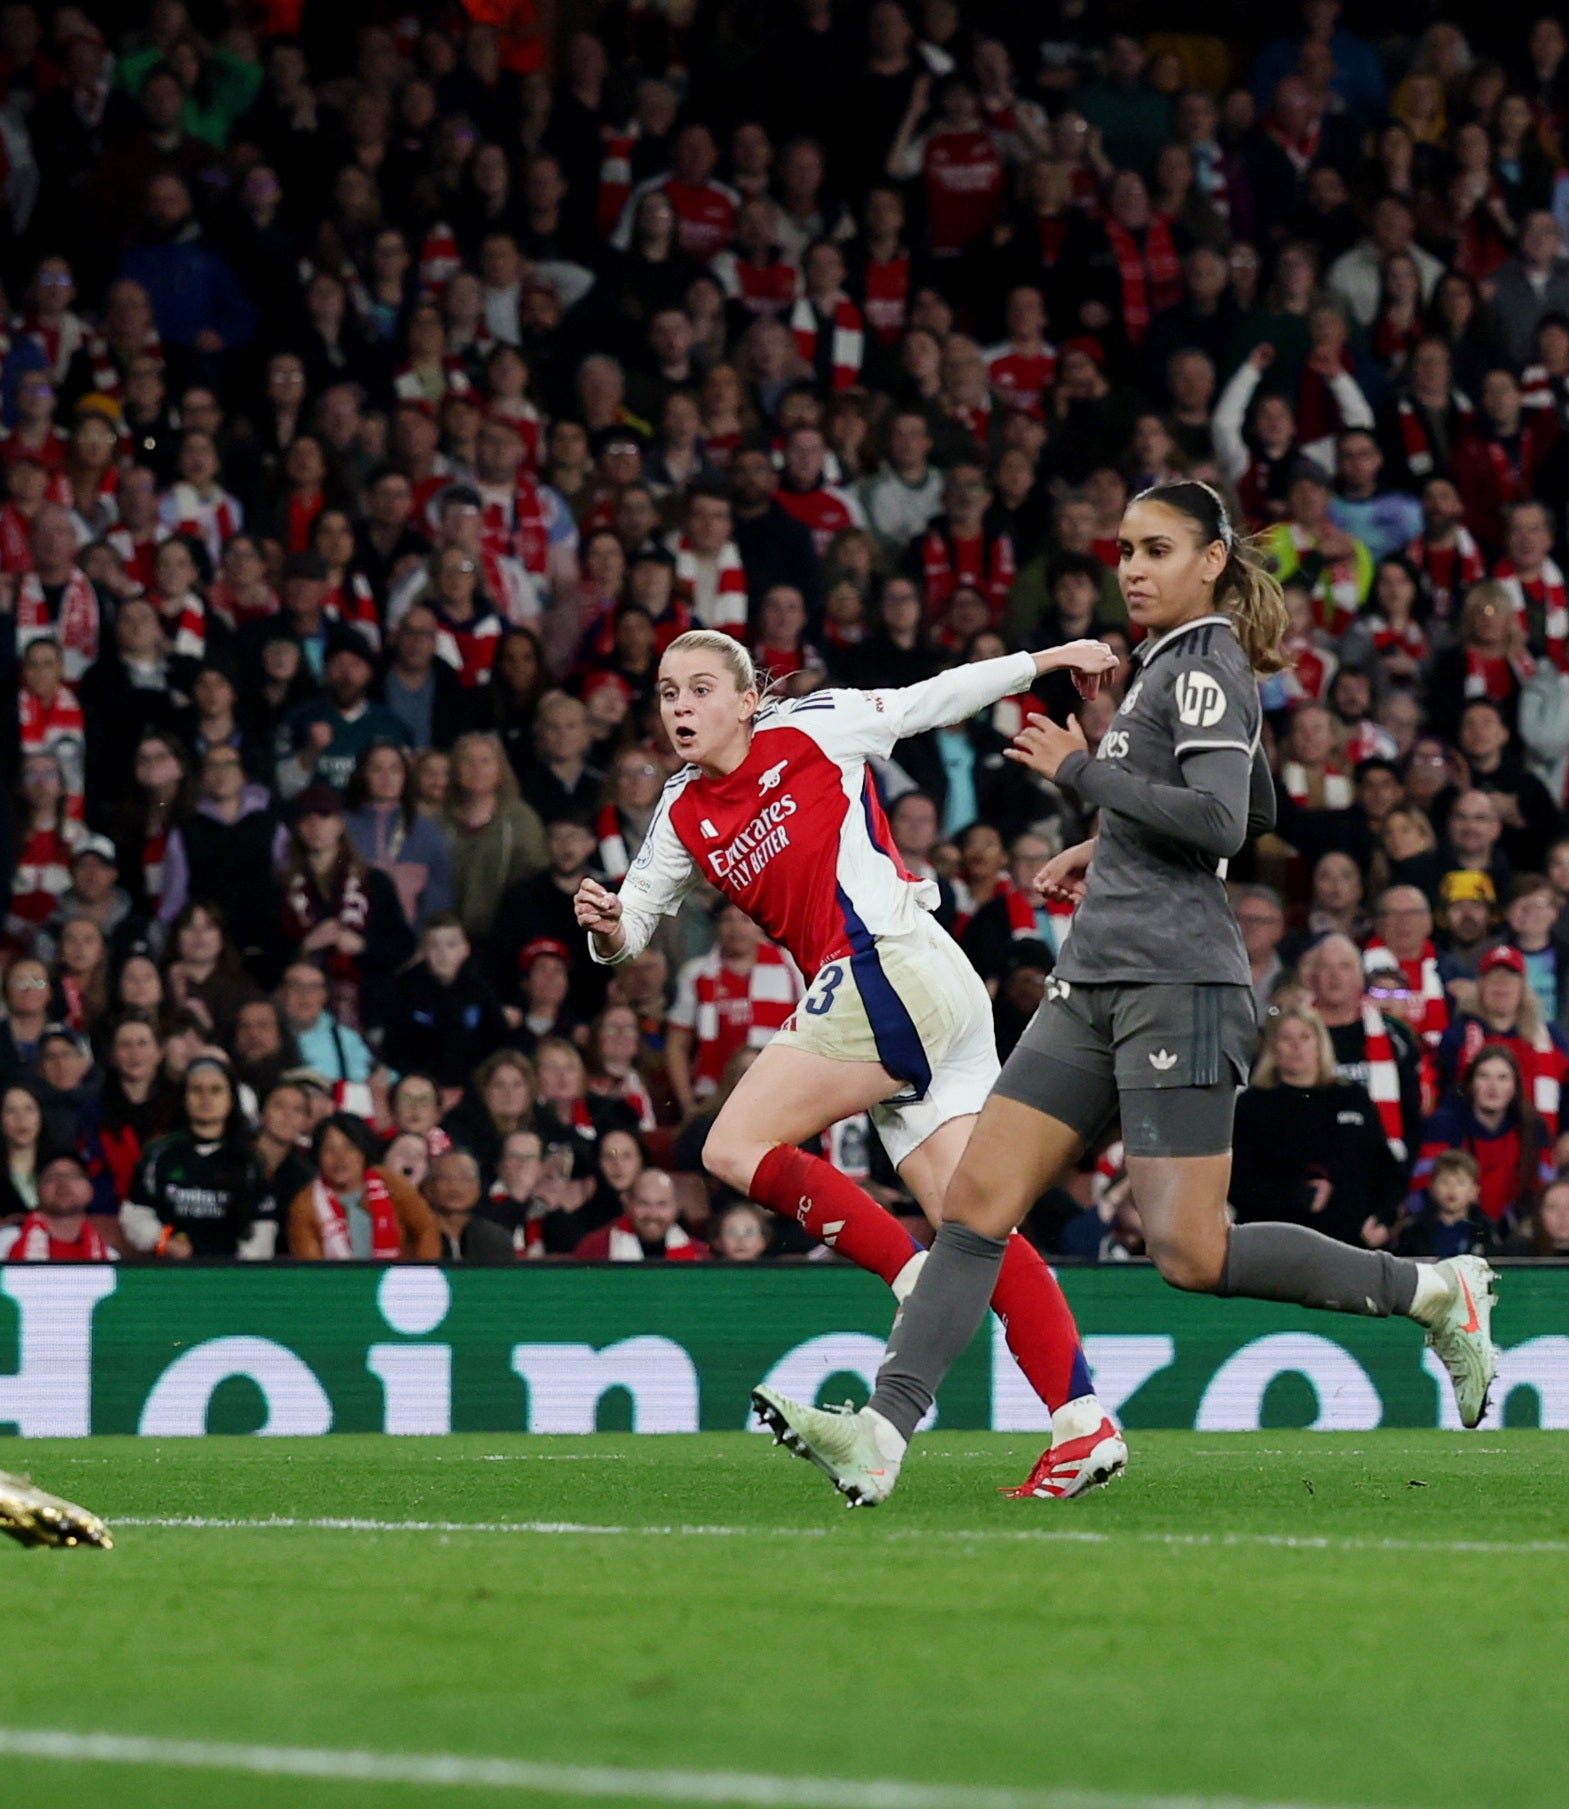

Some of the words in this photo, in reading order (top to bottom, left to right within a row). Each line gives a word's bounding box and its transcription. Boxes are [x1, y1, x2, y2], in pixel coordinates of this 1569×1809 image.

[1179, 671, 1222, 727] hp
[728, 860, 753, 892] FLY
[749, 825, 791, 875] BETTER
